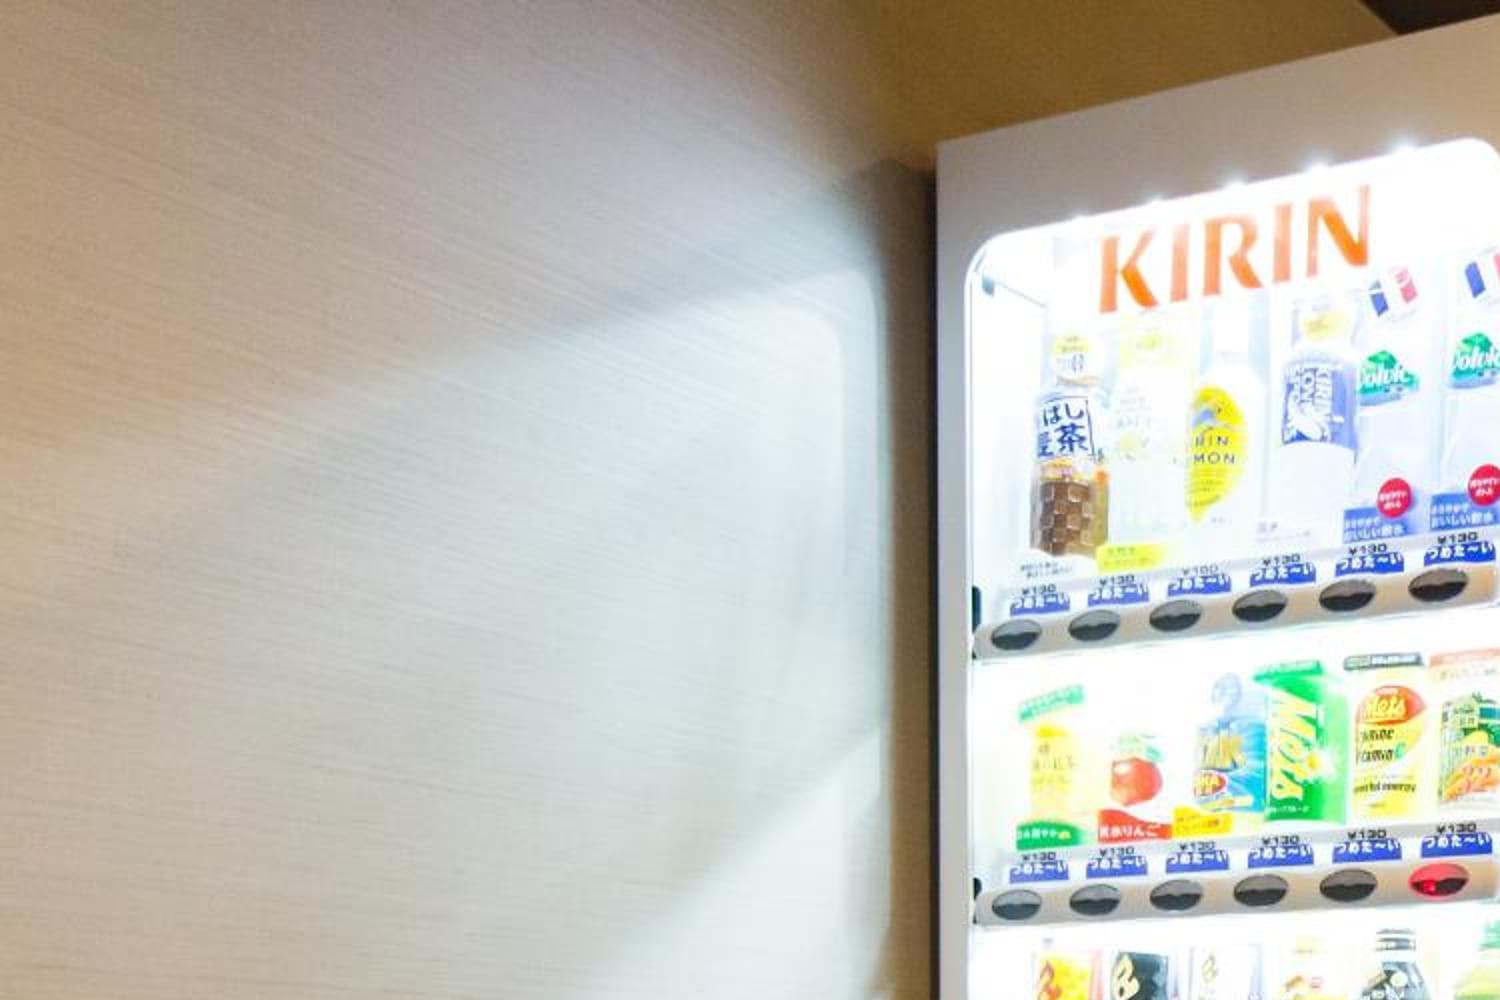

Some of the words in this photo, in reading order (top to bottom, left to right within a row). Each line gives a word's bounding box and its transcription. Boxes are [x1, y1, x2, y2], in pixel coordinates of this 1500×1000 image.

[1099, 184, 1371, 314] KIRIN
[1436, 531, 1478, 544] ¥130
[1347, 828, 1387, 839] ¥130
[1436, 822, 1477, 834] ¥130
